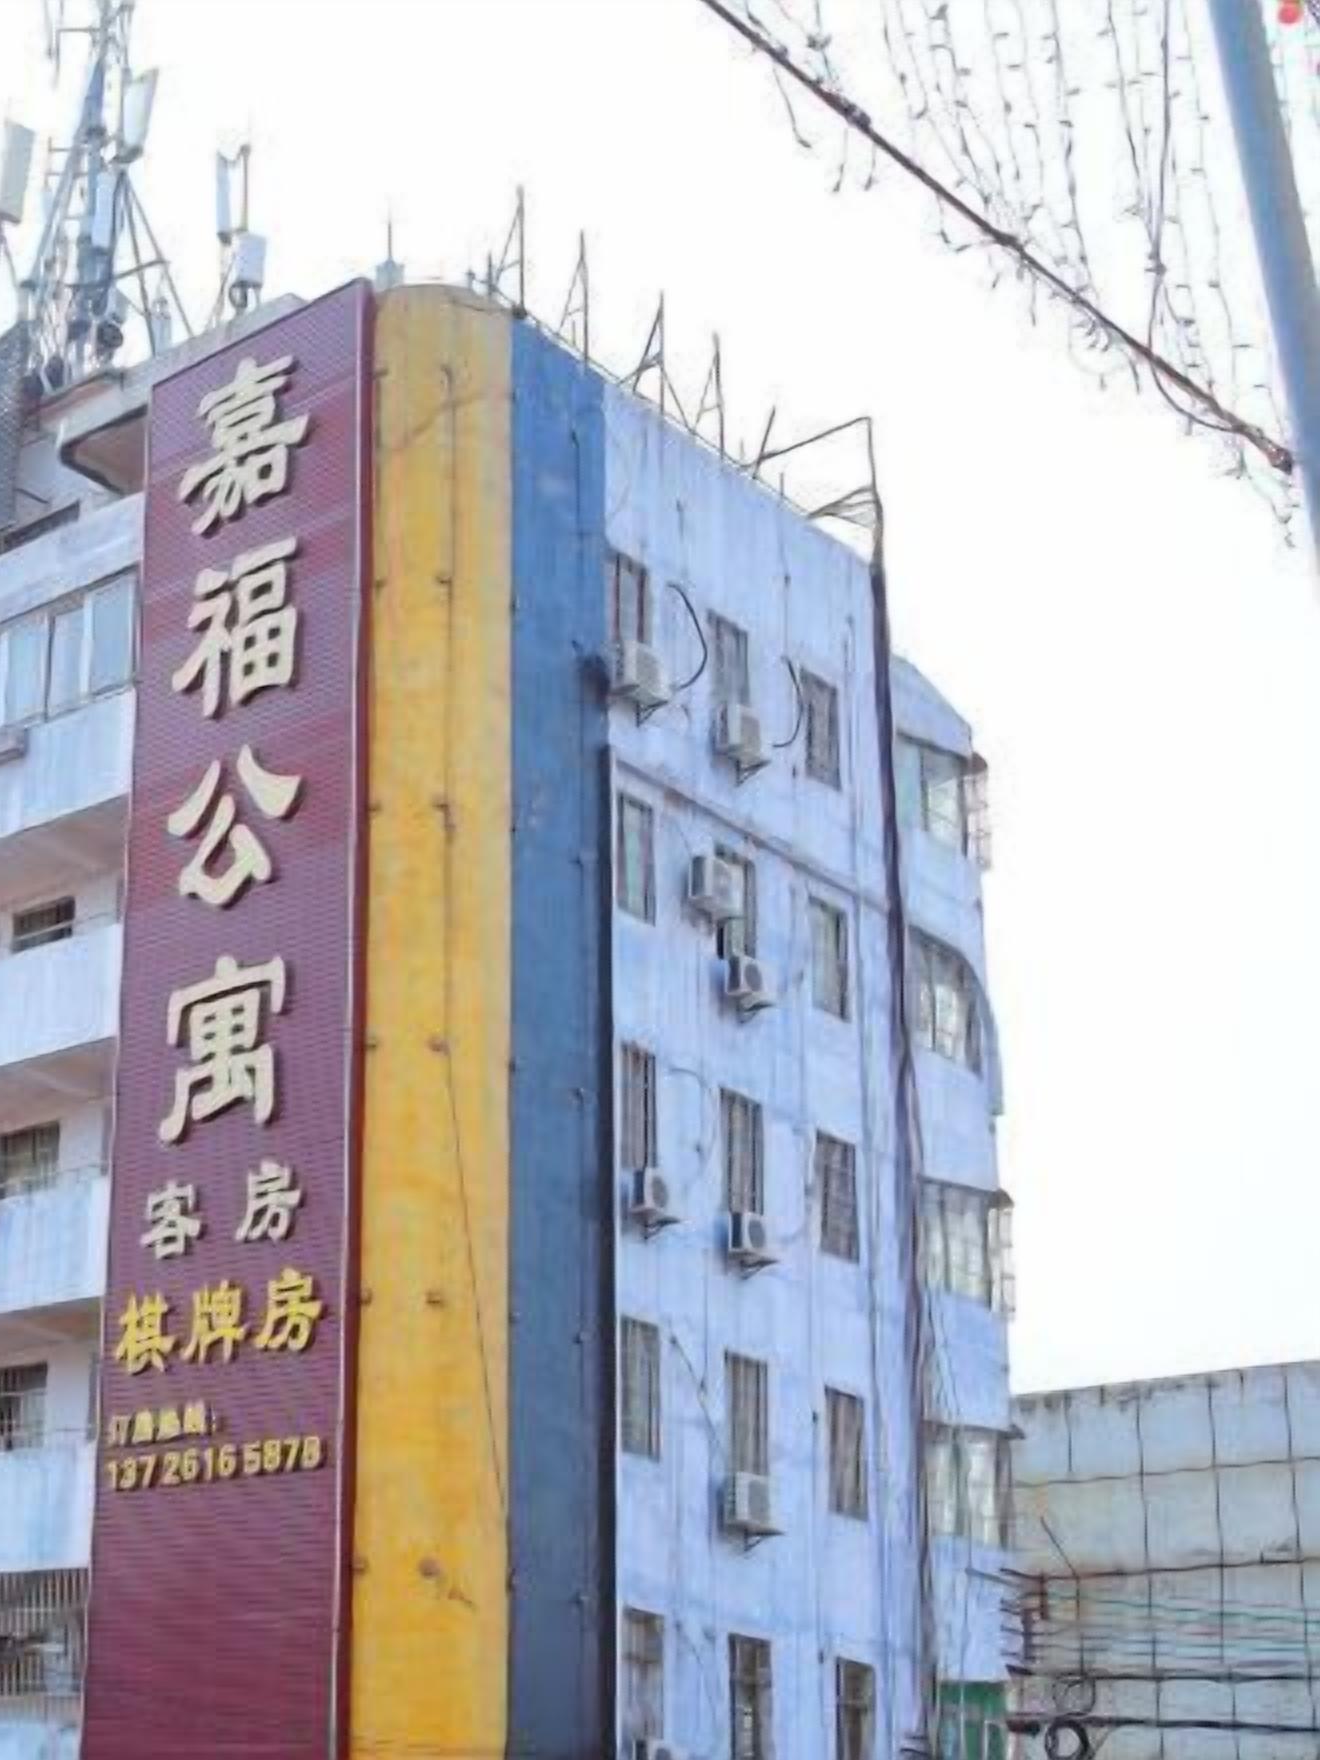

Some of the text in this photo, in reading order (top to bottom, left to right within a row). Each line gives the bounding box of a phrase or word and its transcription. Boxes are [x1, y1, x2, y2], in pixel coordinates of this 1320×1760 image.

[159, 354, 310, 1143] 嘉福公寓
[140, 1160, 301, 1260] 客房
[115, 1268, 322, 1374] 棋牌房
